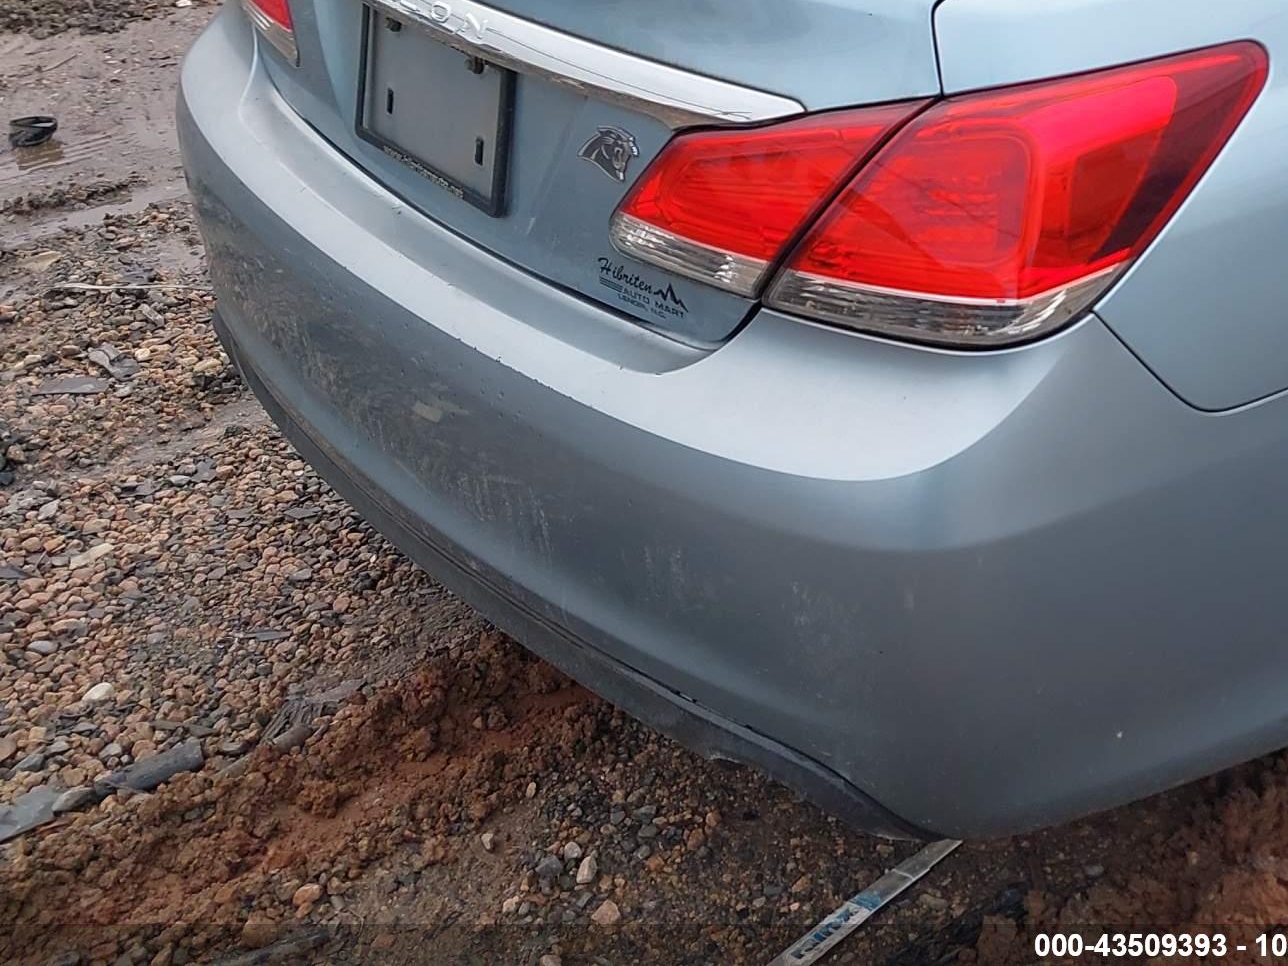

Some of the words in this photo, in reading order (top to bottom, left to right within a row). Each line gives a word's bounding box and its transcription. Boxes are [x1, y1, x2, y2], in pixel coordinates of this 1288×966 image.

[597, 257, 653, 295] Hibriten
[622, 287, 651, 305] AUTO
[654, 300, 685, 319] MART
